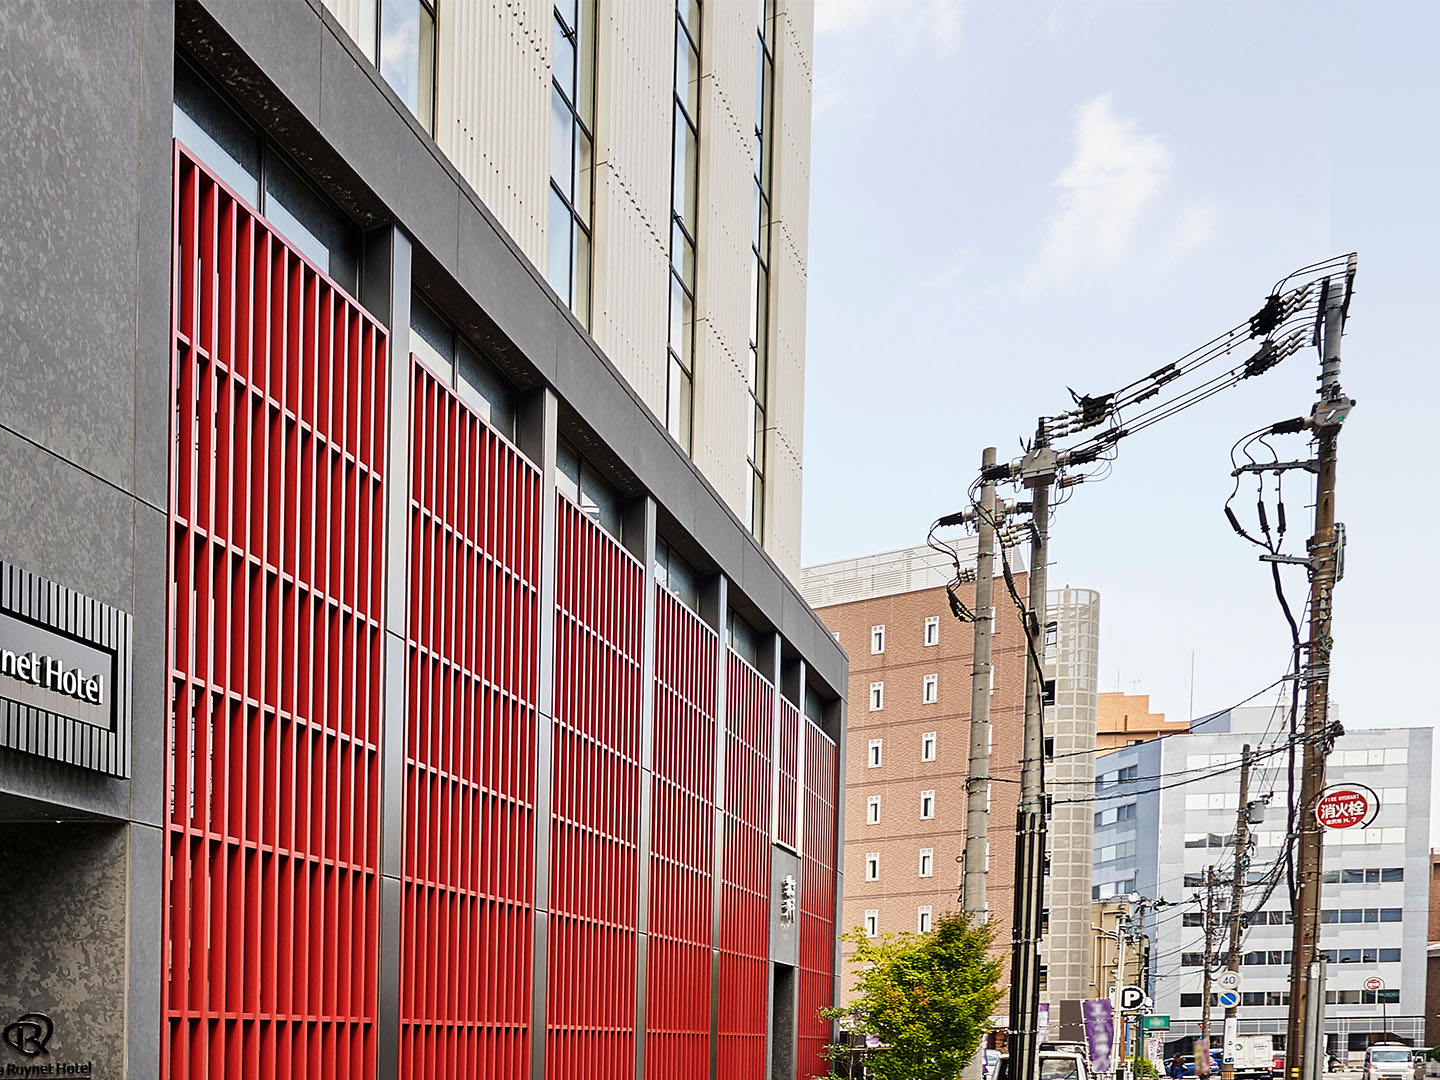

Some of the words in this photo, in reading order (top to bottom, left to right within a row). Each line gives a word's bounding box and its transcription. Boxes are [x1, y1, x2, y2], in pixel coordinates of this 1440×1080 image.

[44, 655, 105, 706] Hotel
[1321, 800, 1365, 819] 消火栓
[1223, 976, 1237, 985] 40
[1124, 990, 1140, 1007] P
[7, 1063, 54, 1078] Roynet
[56, 1061, 92, 1075] Hotel
